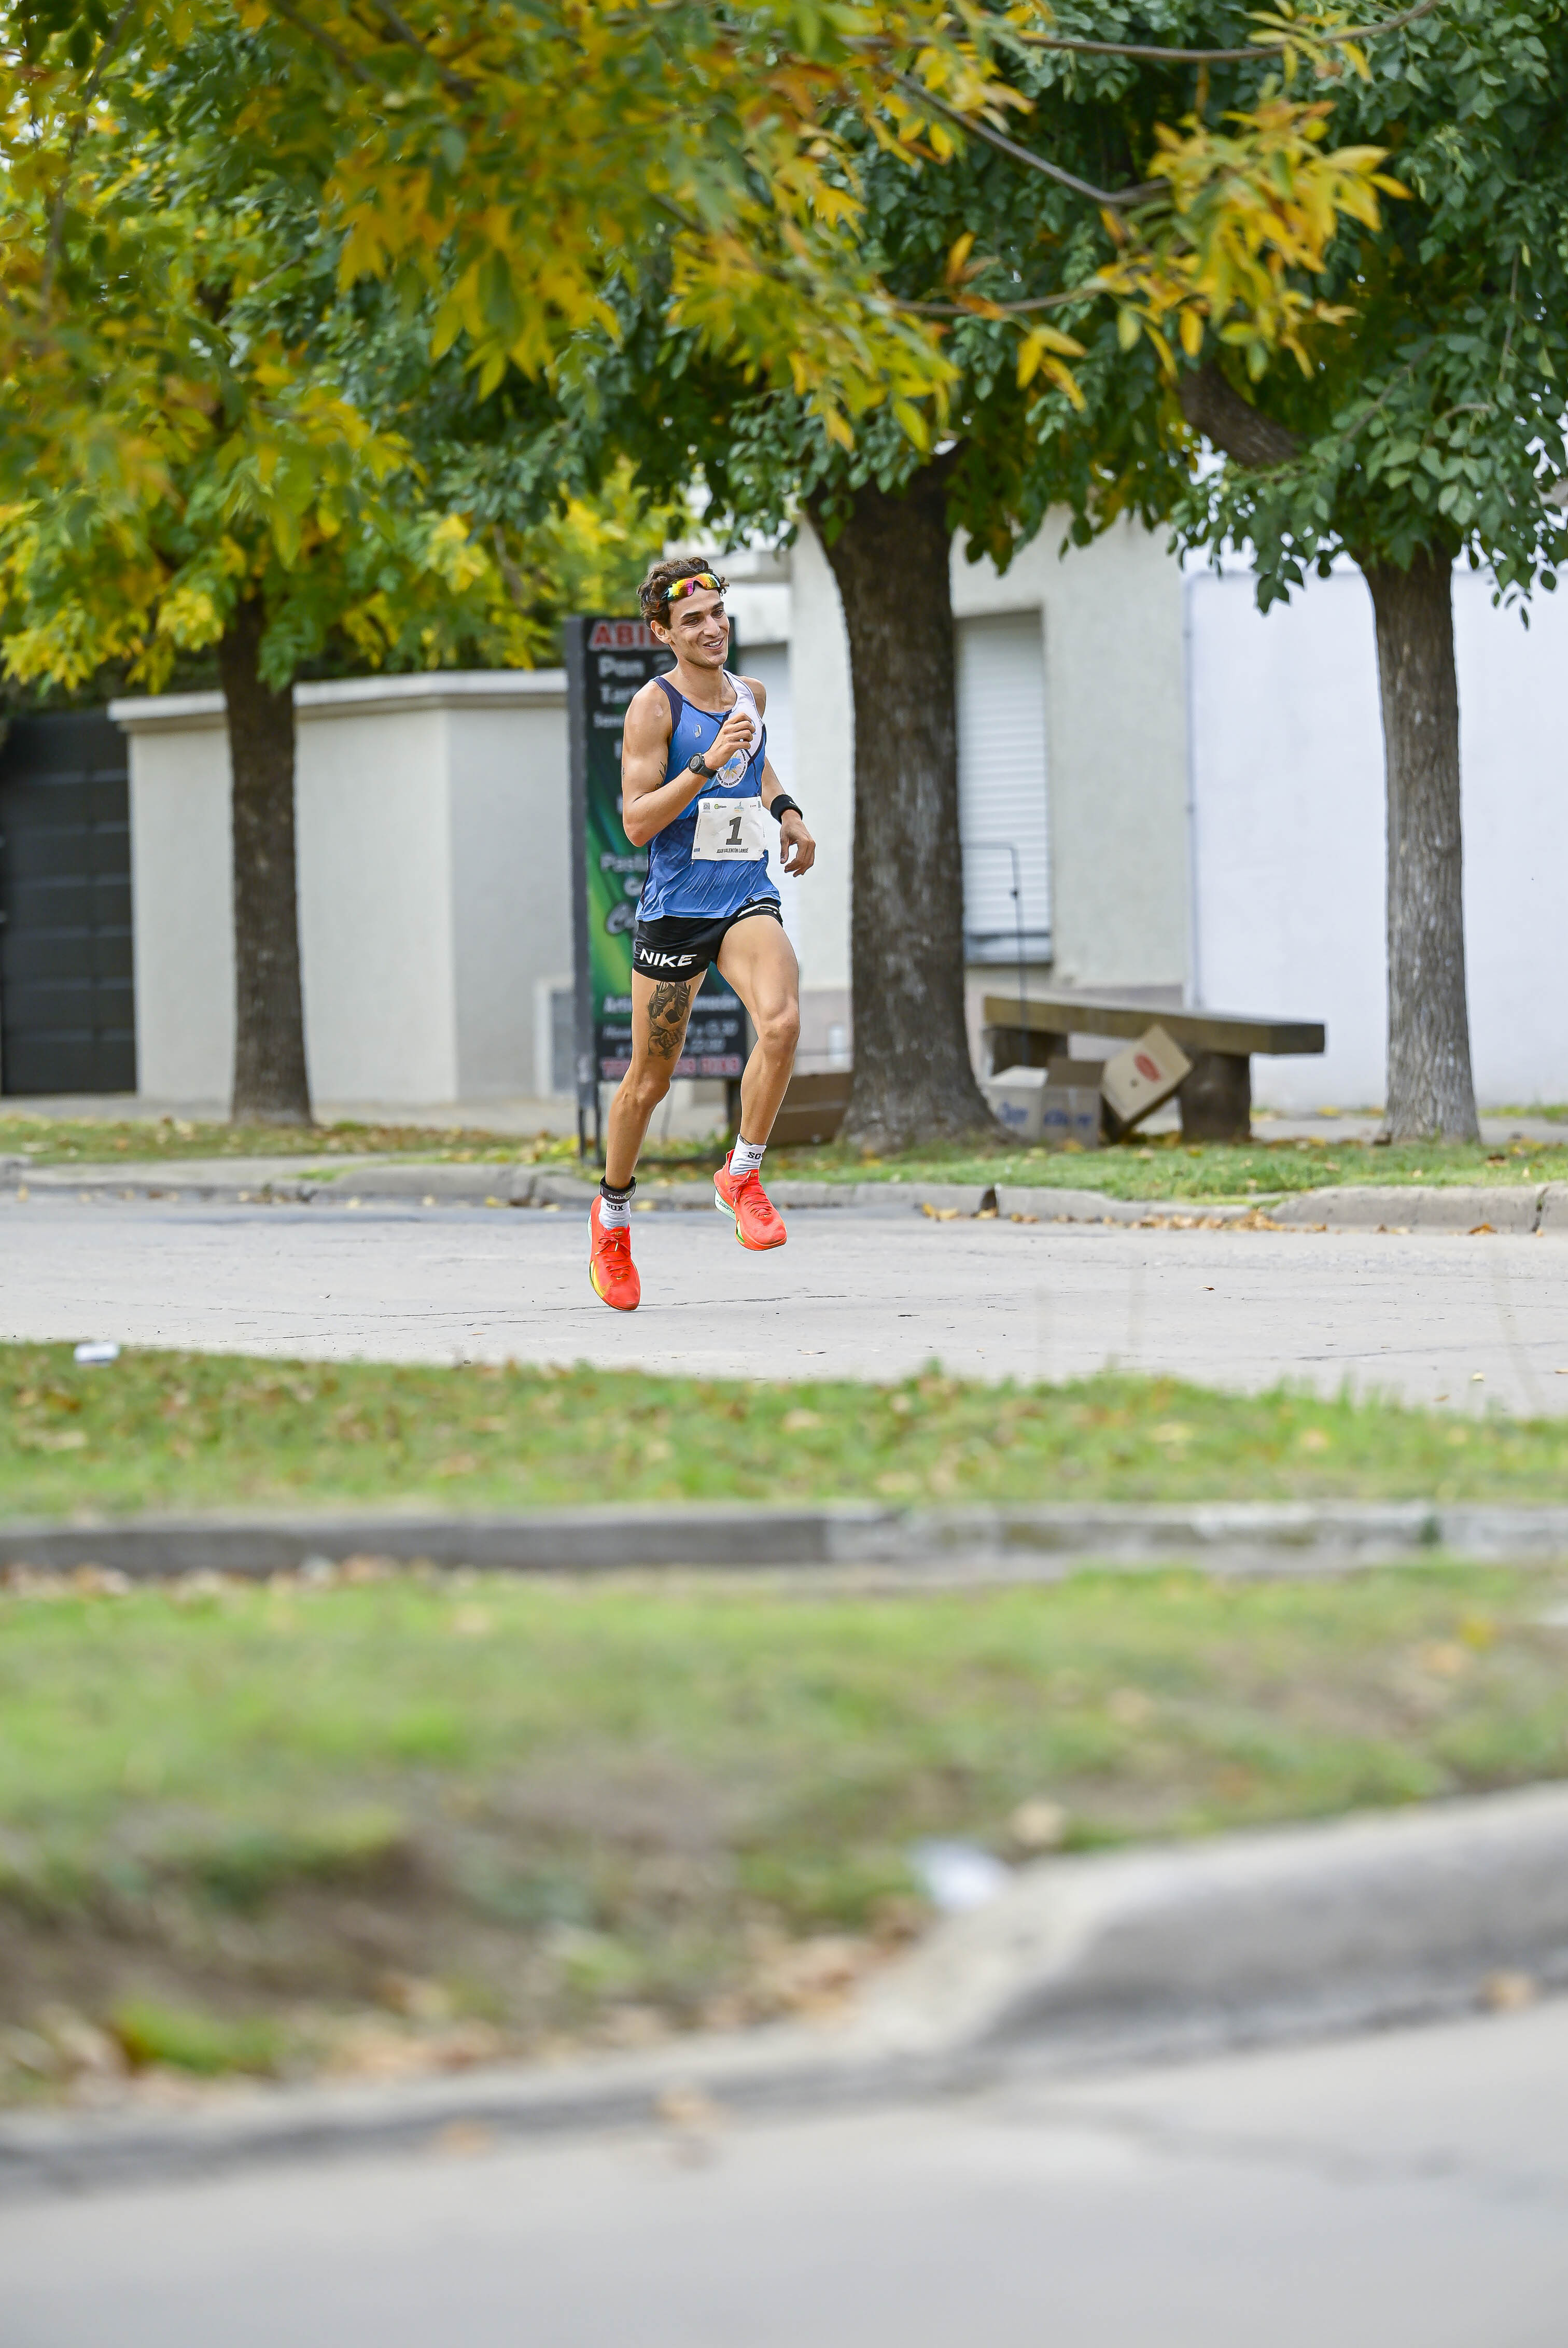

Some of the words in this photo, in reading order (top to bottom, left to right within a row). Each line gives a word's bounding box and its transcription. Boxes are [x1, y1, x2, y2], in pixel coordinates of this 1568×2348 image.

[726, 816, 742, 845] 1
[639, 948, 697, 968] NIKE
[747, 1151, 762, 1160] SO
